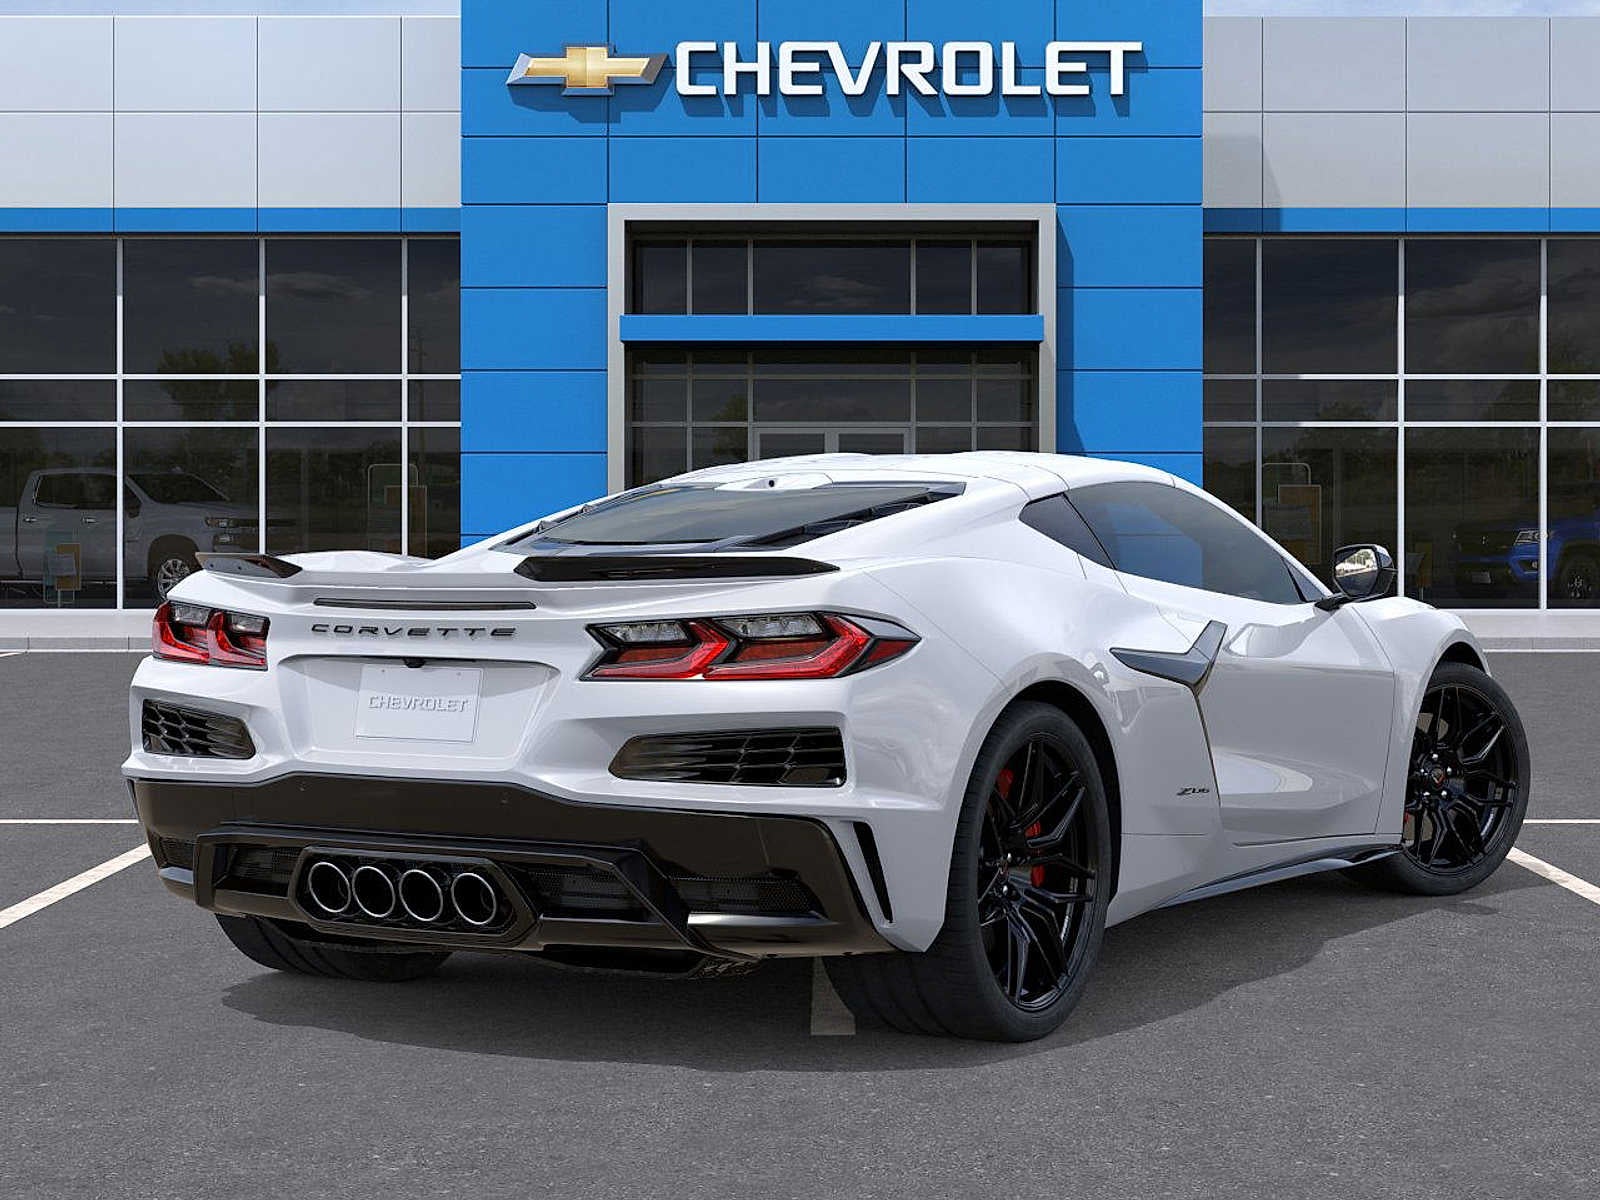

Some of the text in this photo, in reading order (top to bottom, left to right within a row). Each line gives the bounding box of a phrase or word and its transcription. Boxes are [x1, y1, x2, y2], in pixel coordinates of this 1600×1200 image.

[675, 41, 1142, 97] CHEVROLET
[311, 623, 516, 637] CORVETTE
[368, 696, 469, 712] CHEVROLET
